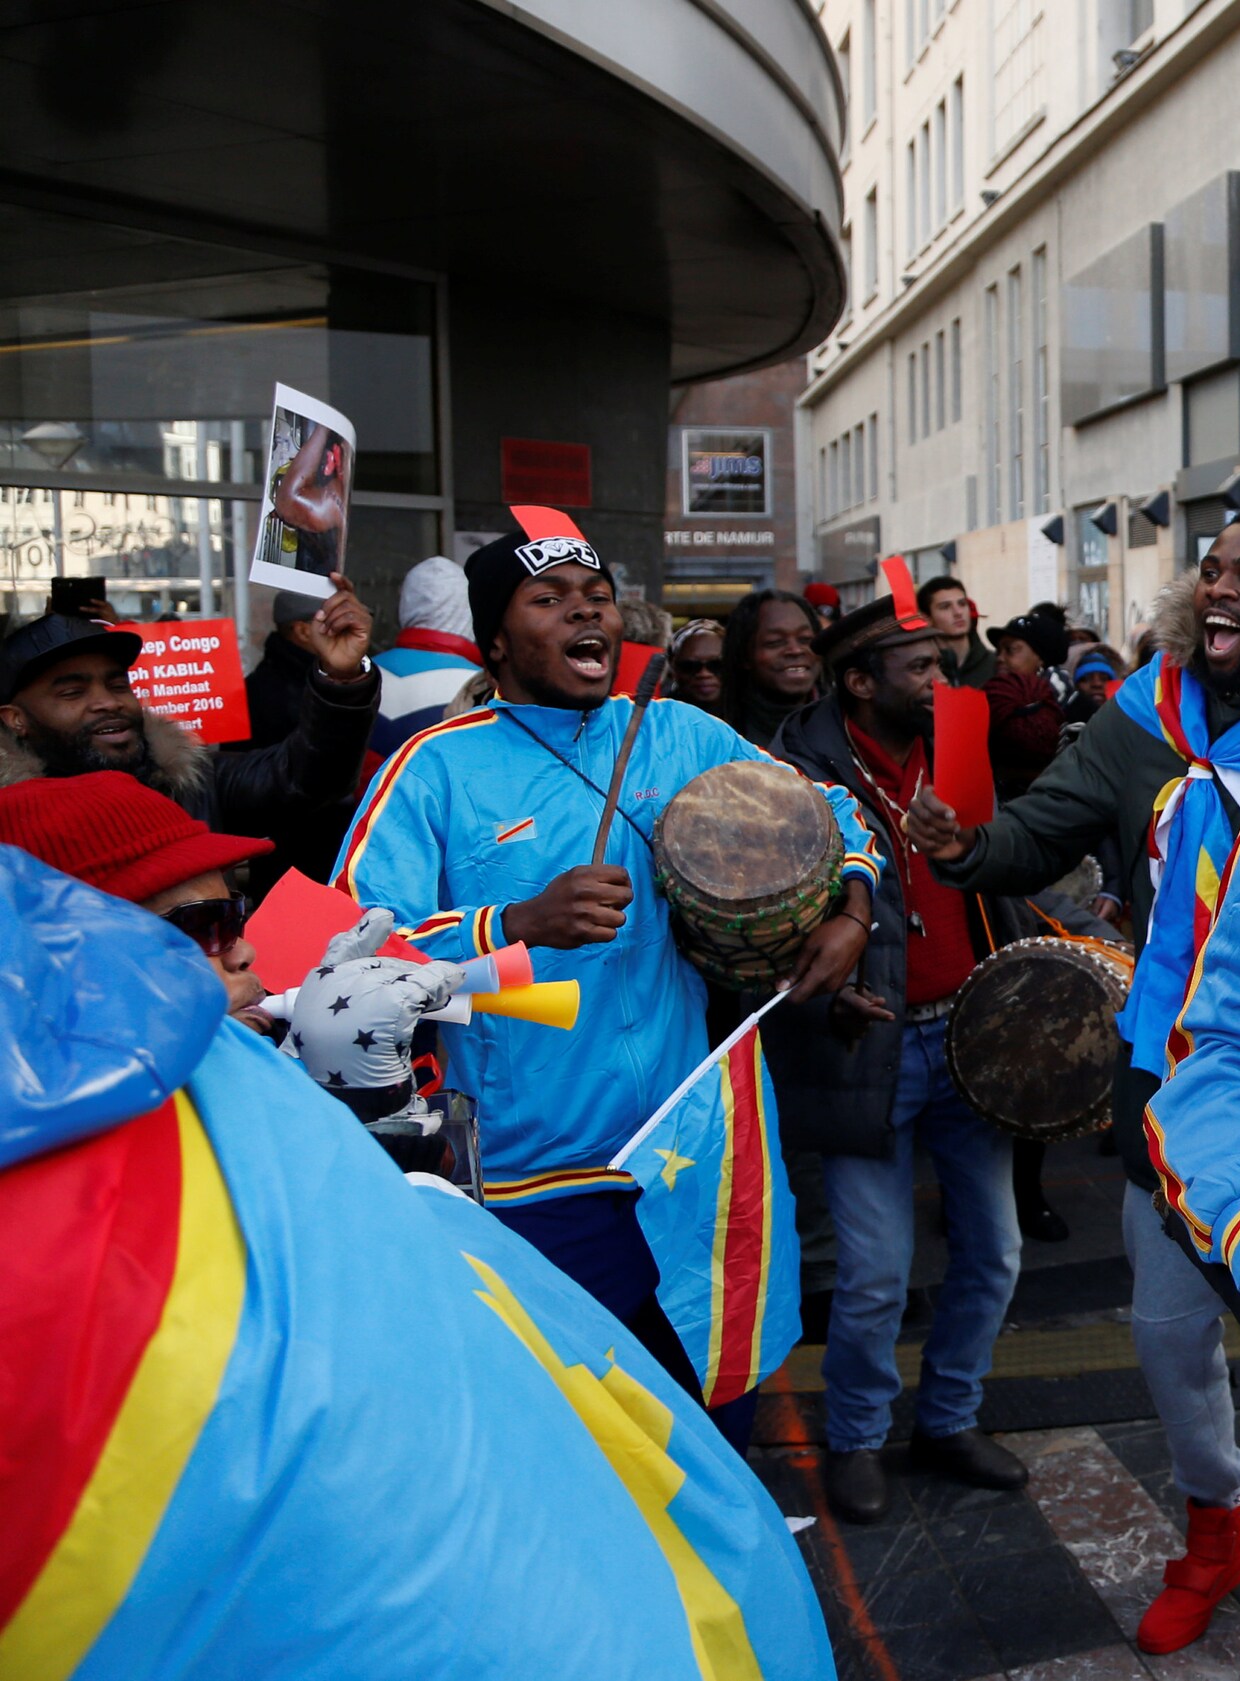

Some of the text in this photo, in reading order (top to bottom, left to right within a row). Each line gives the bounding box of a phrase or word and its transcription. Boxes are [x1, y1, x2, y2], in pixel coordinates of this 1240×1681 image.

[693, 531, 715, 546] DE
[717, 531, 775, 546] NAMUR
[169, 635, 220, 653] Congo
[153, 661, 214, 678] KABILA
[153, 680, 210, 697] Mandaat
[145, 696, 224, 715] ember 2016
